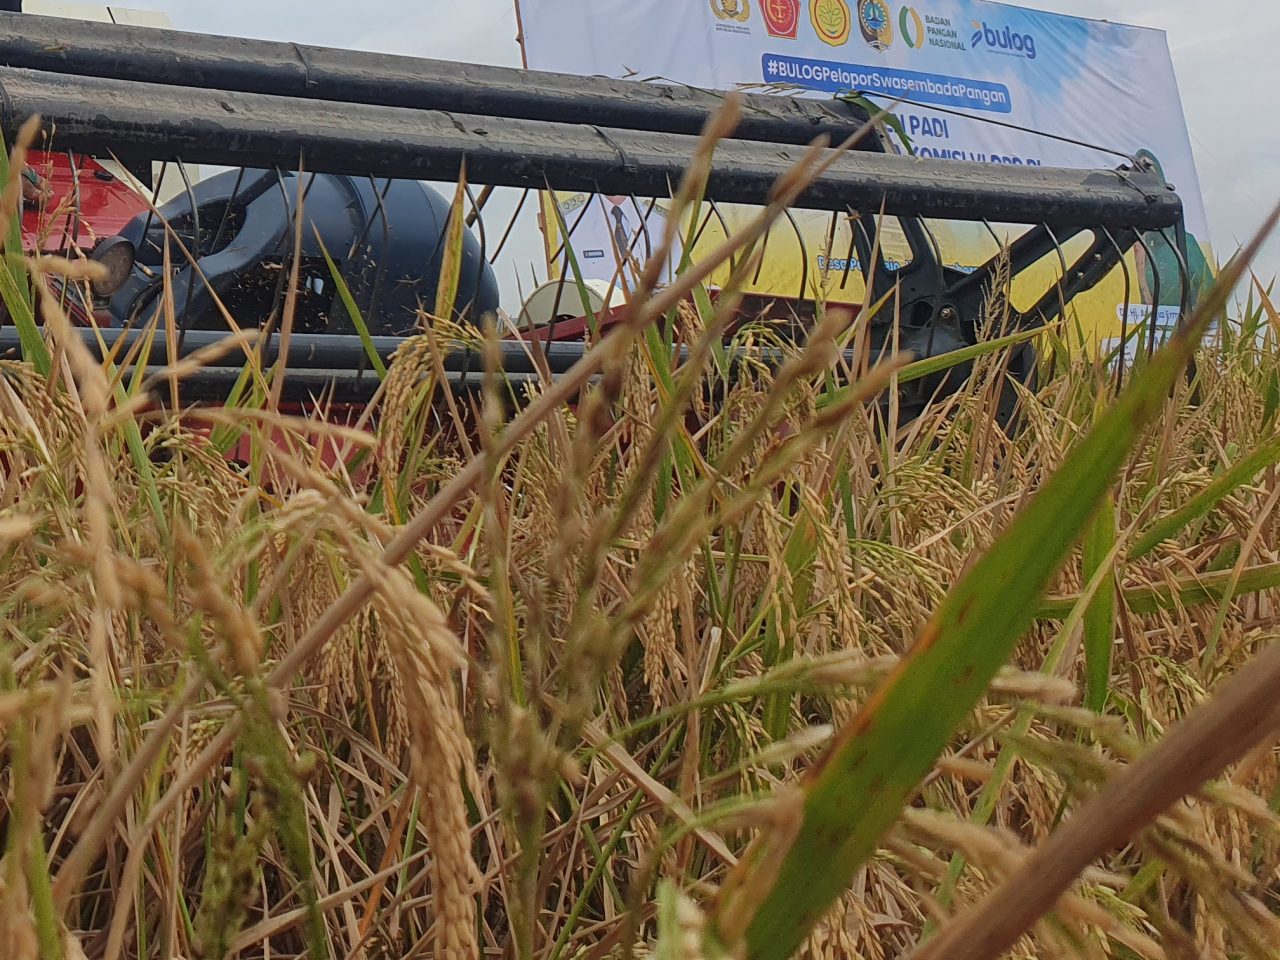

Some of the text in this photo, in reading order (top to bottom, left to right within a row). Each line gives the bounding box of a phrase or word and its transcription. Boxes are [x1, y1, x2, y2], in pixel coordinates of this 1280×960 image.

[924, 14, 951, 27] BADAN
[926, 26, 958, 39] PANGAN
[982, 21, 1037, 60] bulog
[928, 37, 967, 51] NASIONAL
[767, 58, 1007, 106] #BULOGPeloporSwasembadaPangan
[909, 115, 949, 139] PADI
